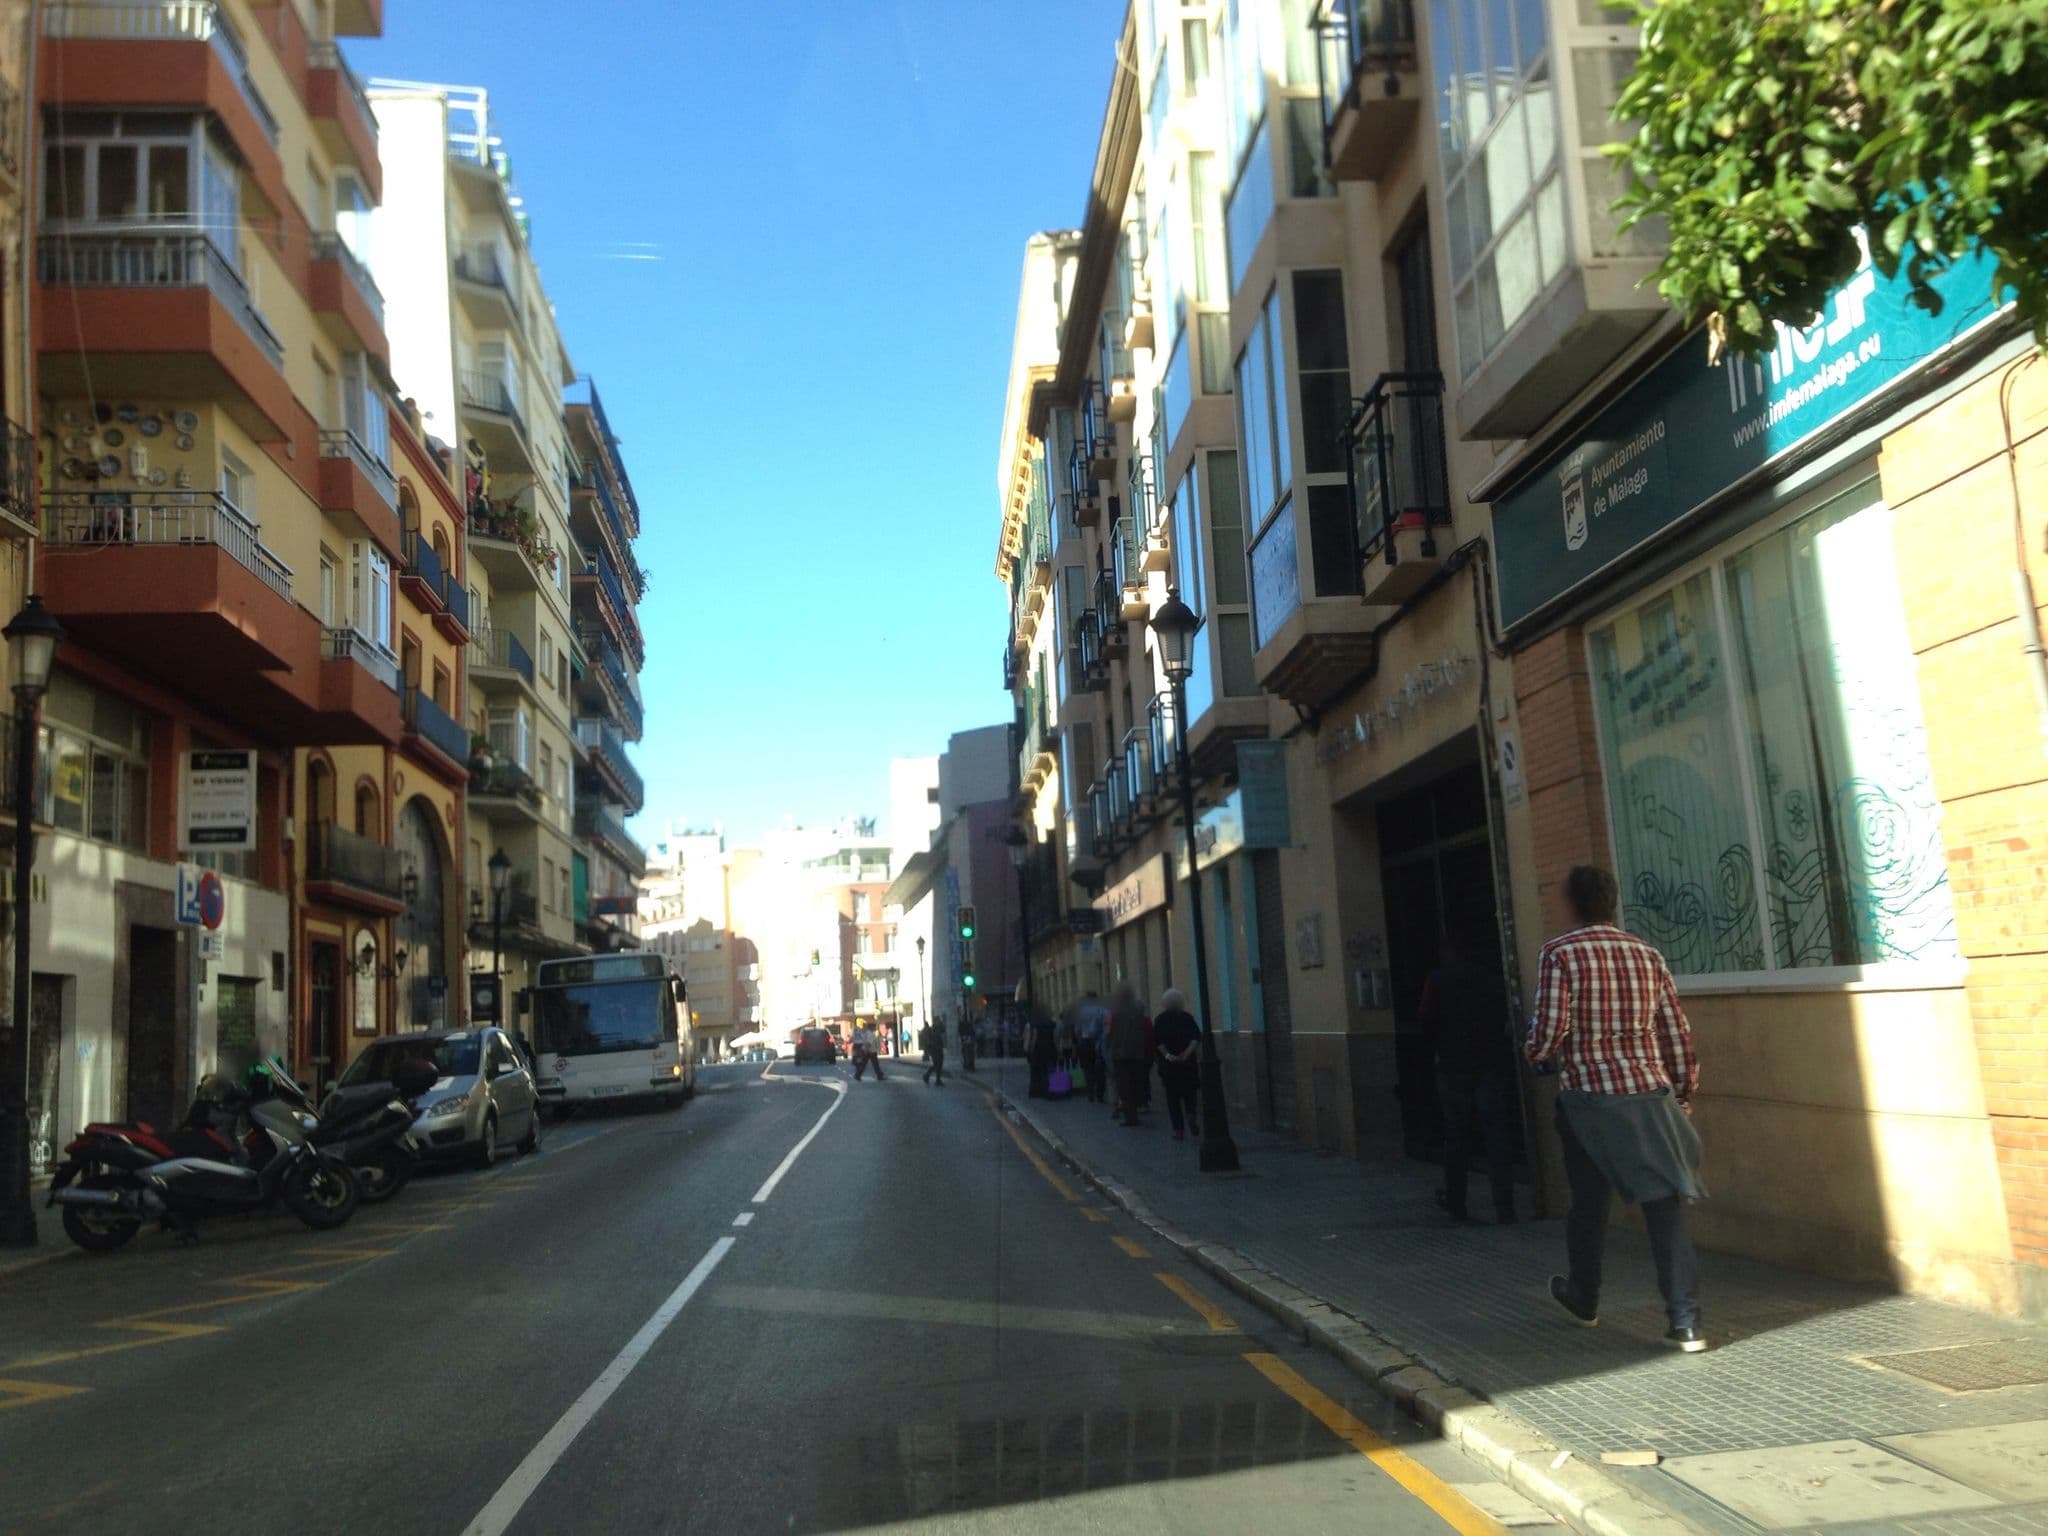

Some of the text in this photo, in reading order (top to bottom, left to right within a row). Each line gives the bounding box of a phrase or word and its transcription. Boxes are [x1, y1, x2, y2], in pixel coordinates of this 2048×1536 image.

[1733, 332, 1881, 449] www.imfemalaga.eu
[1591, 420, 1665, 488] Ayuntamiento
[1594, 467, 1648, 518] de Málaga
